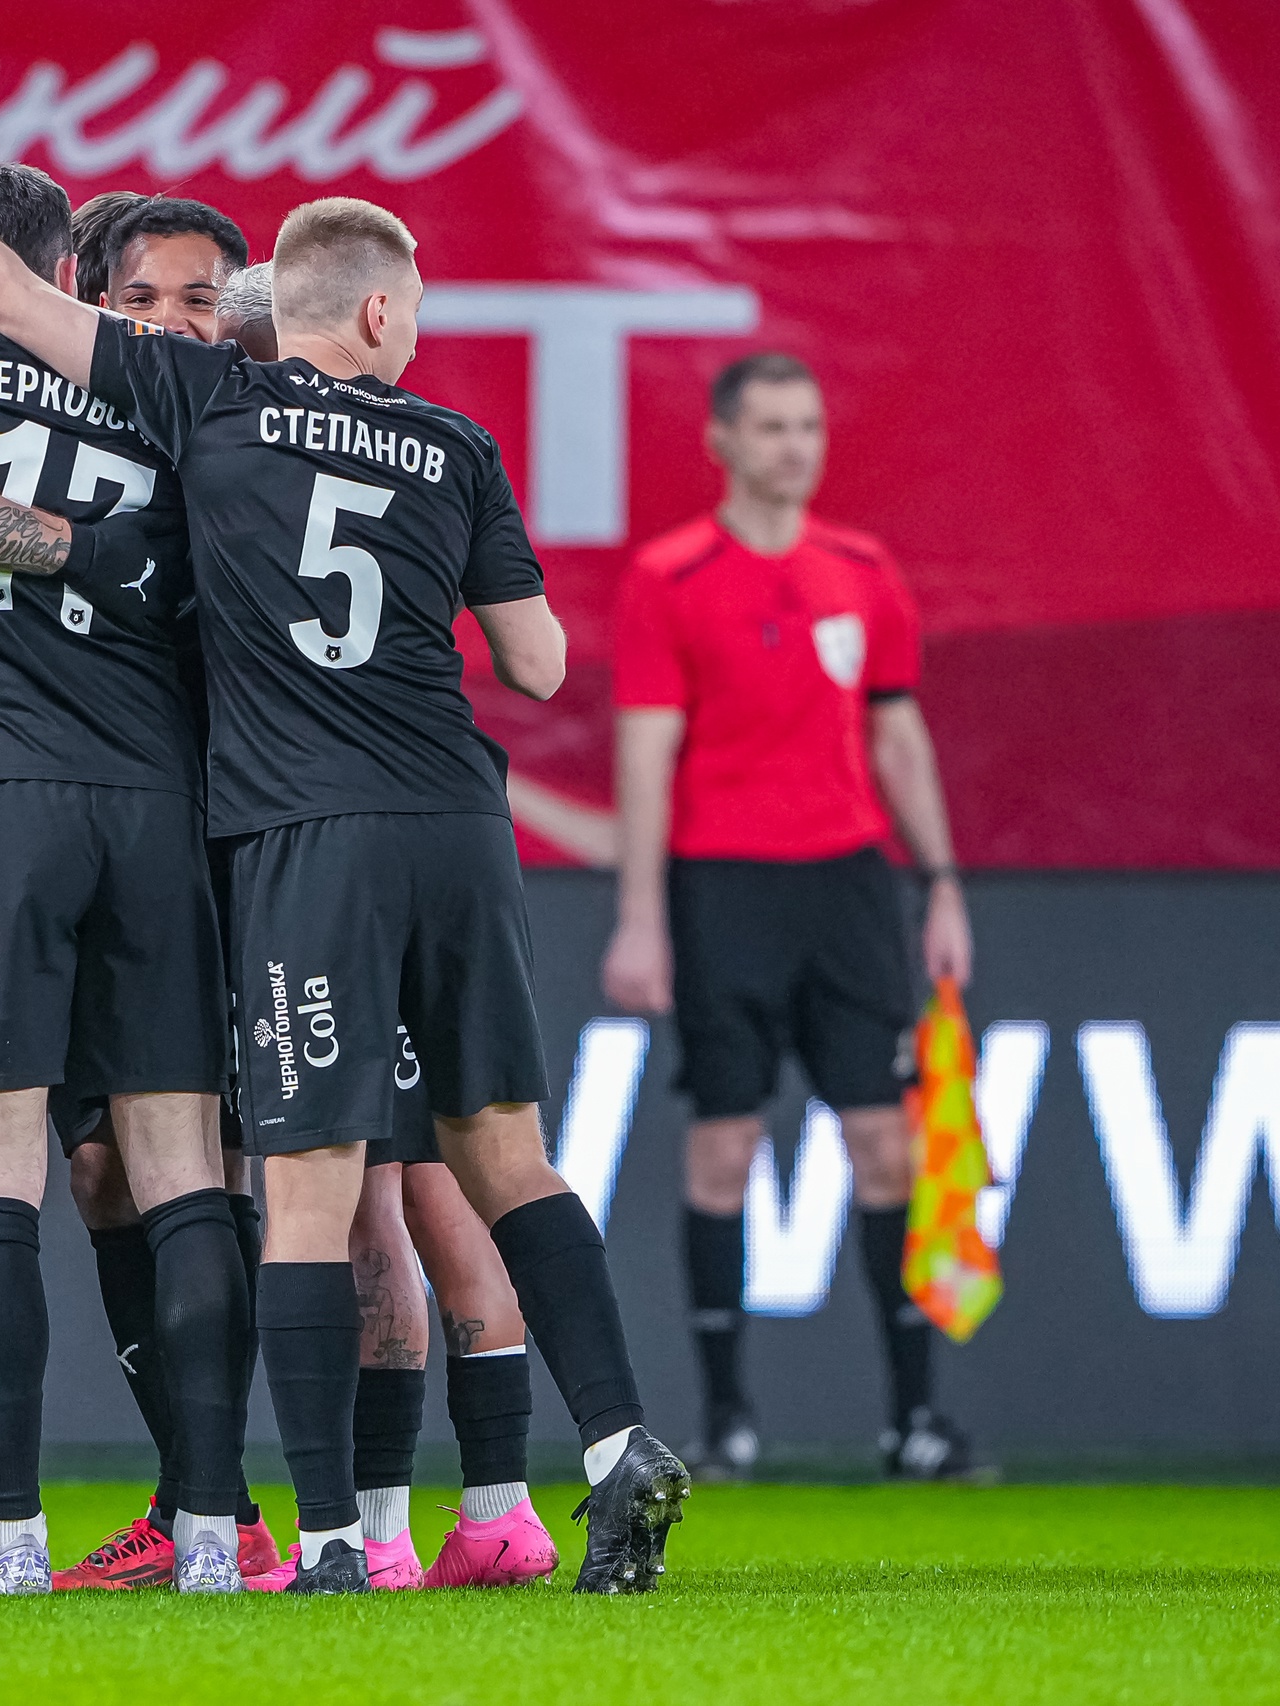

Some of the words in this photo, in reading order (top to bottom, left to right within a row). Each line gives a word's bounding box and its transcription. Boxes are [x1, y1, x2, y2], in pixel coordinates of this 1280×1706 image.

[260, 407, 446, 484] СТЕПАНОВ
[289, 473, 396, 669] 5
[297, 976, 339, 1068] Cola
[395, 1025, 421, 1090] Co
